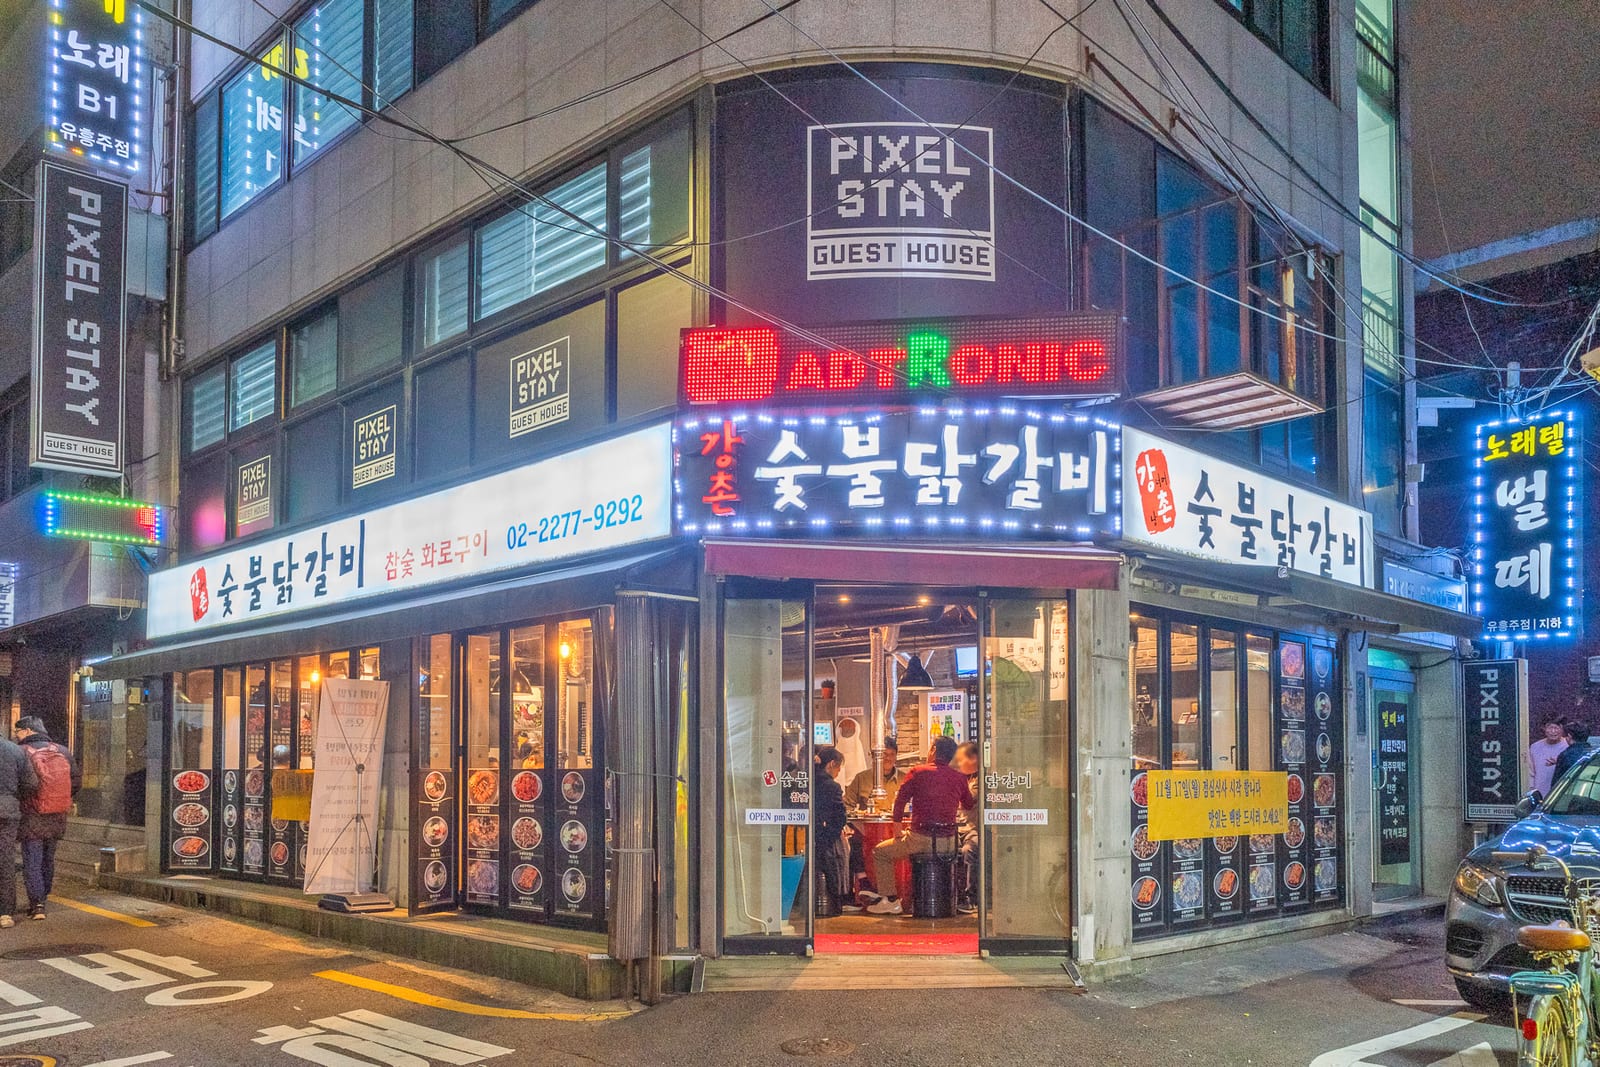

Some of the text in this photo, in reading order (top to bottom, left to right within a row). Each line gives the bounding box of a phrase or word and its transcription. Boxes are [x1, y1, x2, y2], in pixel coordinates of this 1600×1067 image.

[61, 30, 129, 84] 노래
[78, 84, 116, 119] B1
[60, 122, 129, 159] 유흥주점
[830, 135, 970, 176] PIXEL
[837, 179, 964, 218] STAY
[813, 242, 990, 266] GUEST HOUSE
[65, 186, 102, 426] PIXEL STAY
[517, 347, 562, 382] PIXEL
[785, 332, 1108, 390] ADTRONIC
[518, 370, 560, 404] STAY
[358, 414, 391, 441] PIXEL
[511, 401, 568, 431] GUEST HOUSE
[46, 439, 113, 458] GUEST HOUSE
[359, 434, 389, 461] STAY
[1483, 421, 1565, 462] 노래텔
[242, 464, 267, 485] PIXEL
[354, 460, 394, 482] GUEST HOUSE
[700, 420, 743, 517] 강촌
[754, 424, 1107, 515] 숯불닭갈비
[242, 480, 265, 501] STAY
[1137, 454, 1173, 524] 강촌
[507, 493, 643, 551] 02-2277-9292
[1187, 469, 1366, 588] 숯불닭갈비
[1494, 469, 1552, 599] 벌떼
[217, 519, 366, 618] 숯불닭갈비
[385, 529, 489, 582] 참숯 화로구이
[1487, 617, 1562, 633] 유흥주점 지하
[1479, 668, 1502, 798] PIXEL STAY
[780, 771, 808, 788] 숯불
[985, 771, 1031, 789] 닭갈비
[1155, 778, 1262, 799] 11월 17일(월) 점심식사 시작 합니다
[749, 812, 806, 823] OPEN pm 3:30
[987, 812, 1044, 823] CLOSE pm 11:00
[1208, 808, 1228, 829] 맛있는
